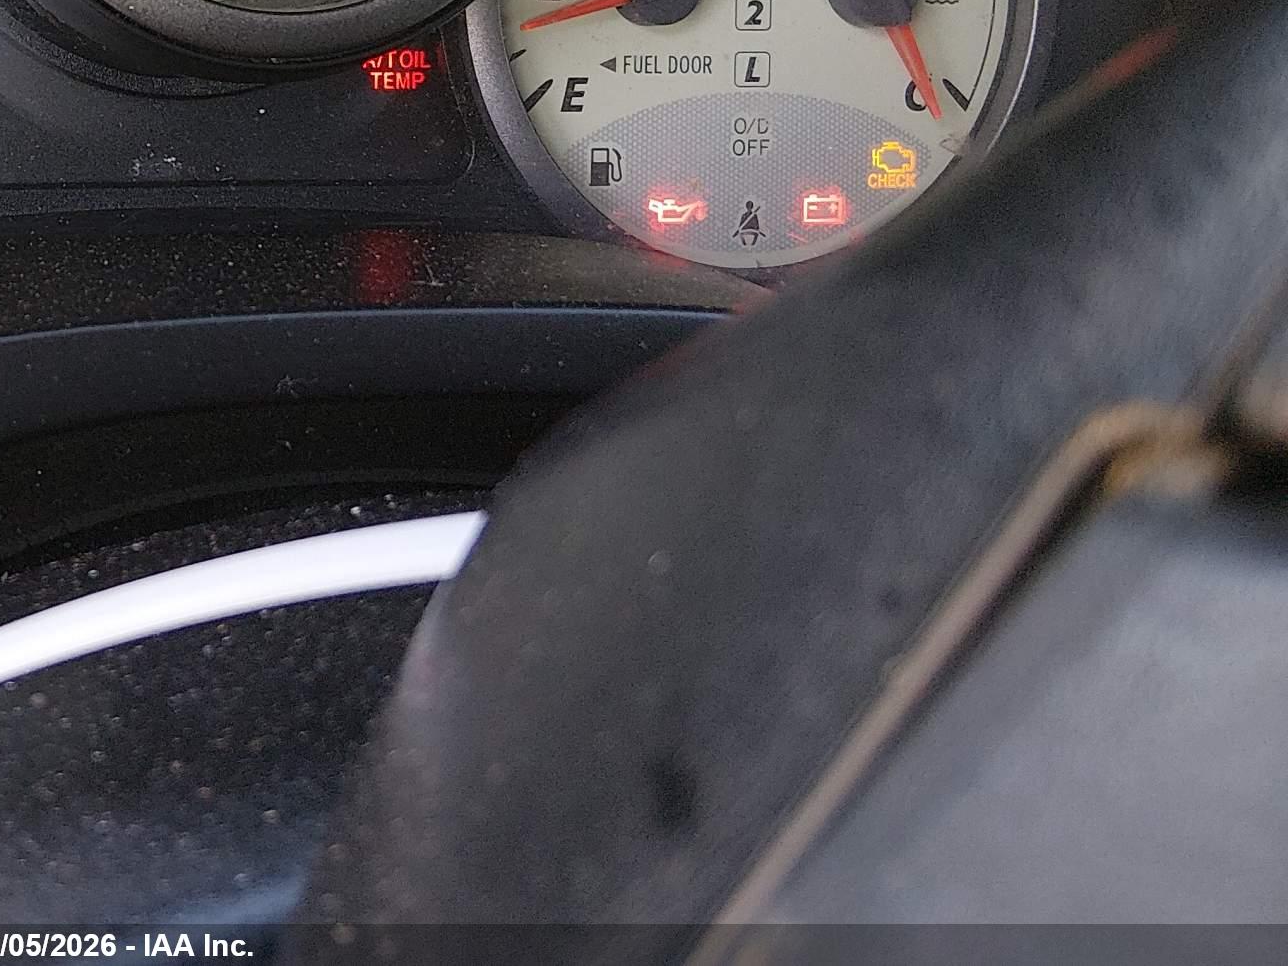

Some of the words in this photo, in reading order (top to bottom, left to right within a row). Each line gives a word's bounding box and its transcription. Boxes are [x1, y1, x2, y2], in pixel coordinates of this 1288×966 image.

[743, 0, 764, 26] 2
[399, 50, 432, 69] OIL
[623, 55, 662, 75] FUEL
[668, 55, 713, 75] DOOR
[744, 57, 760, 83] L
[370, 71, 426, 90] TEMP
[560, 77, 589, 113] E
[733, 117, 770, 136] O/D
[732, 138, 770, 157] OFF
[867, 173, 917, 189] CHECK
